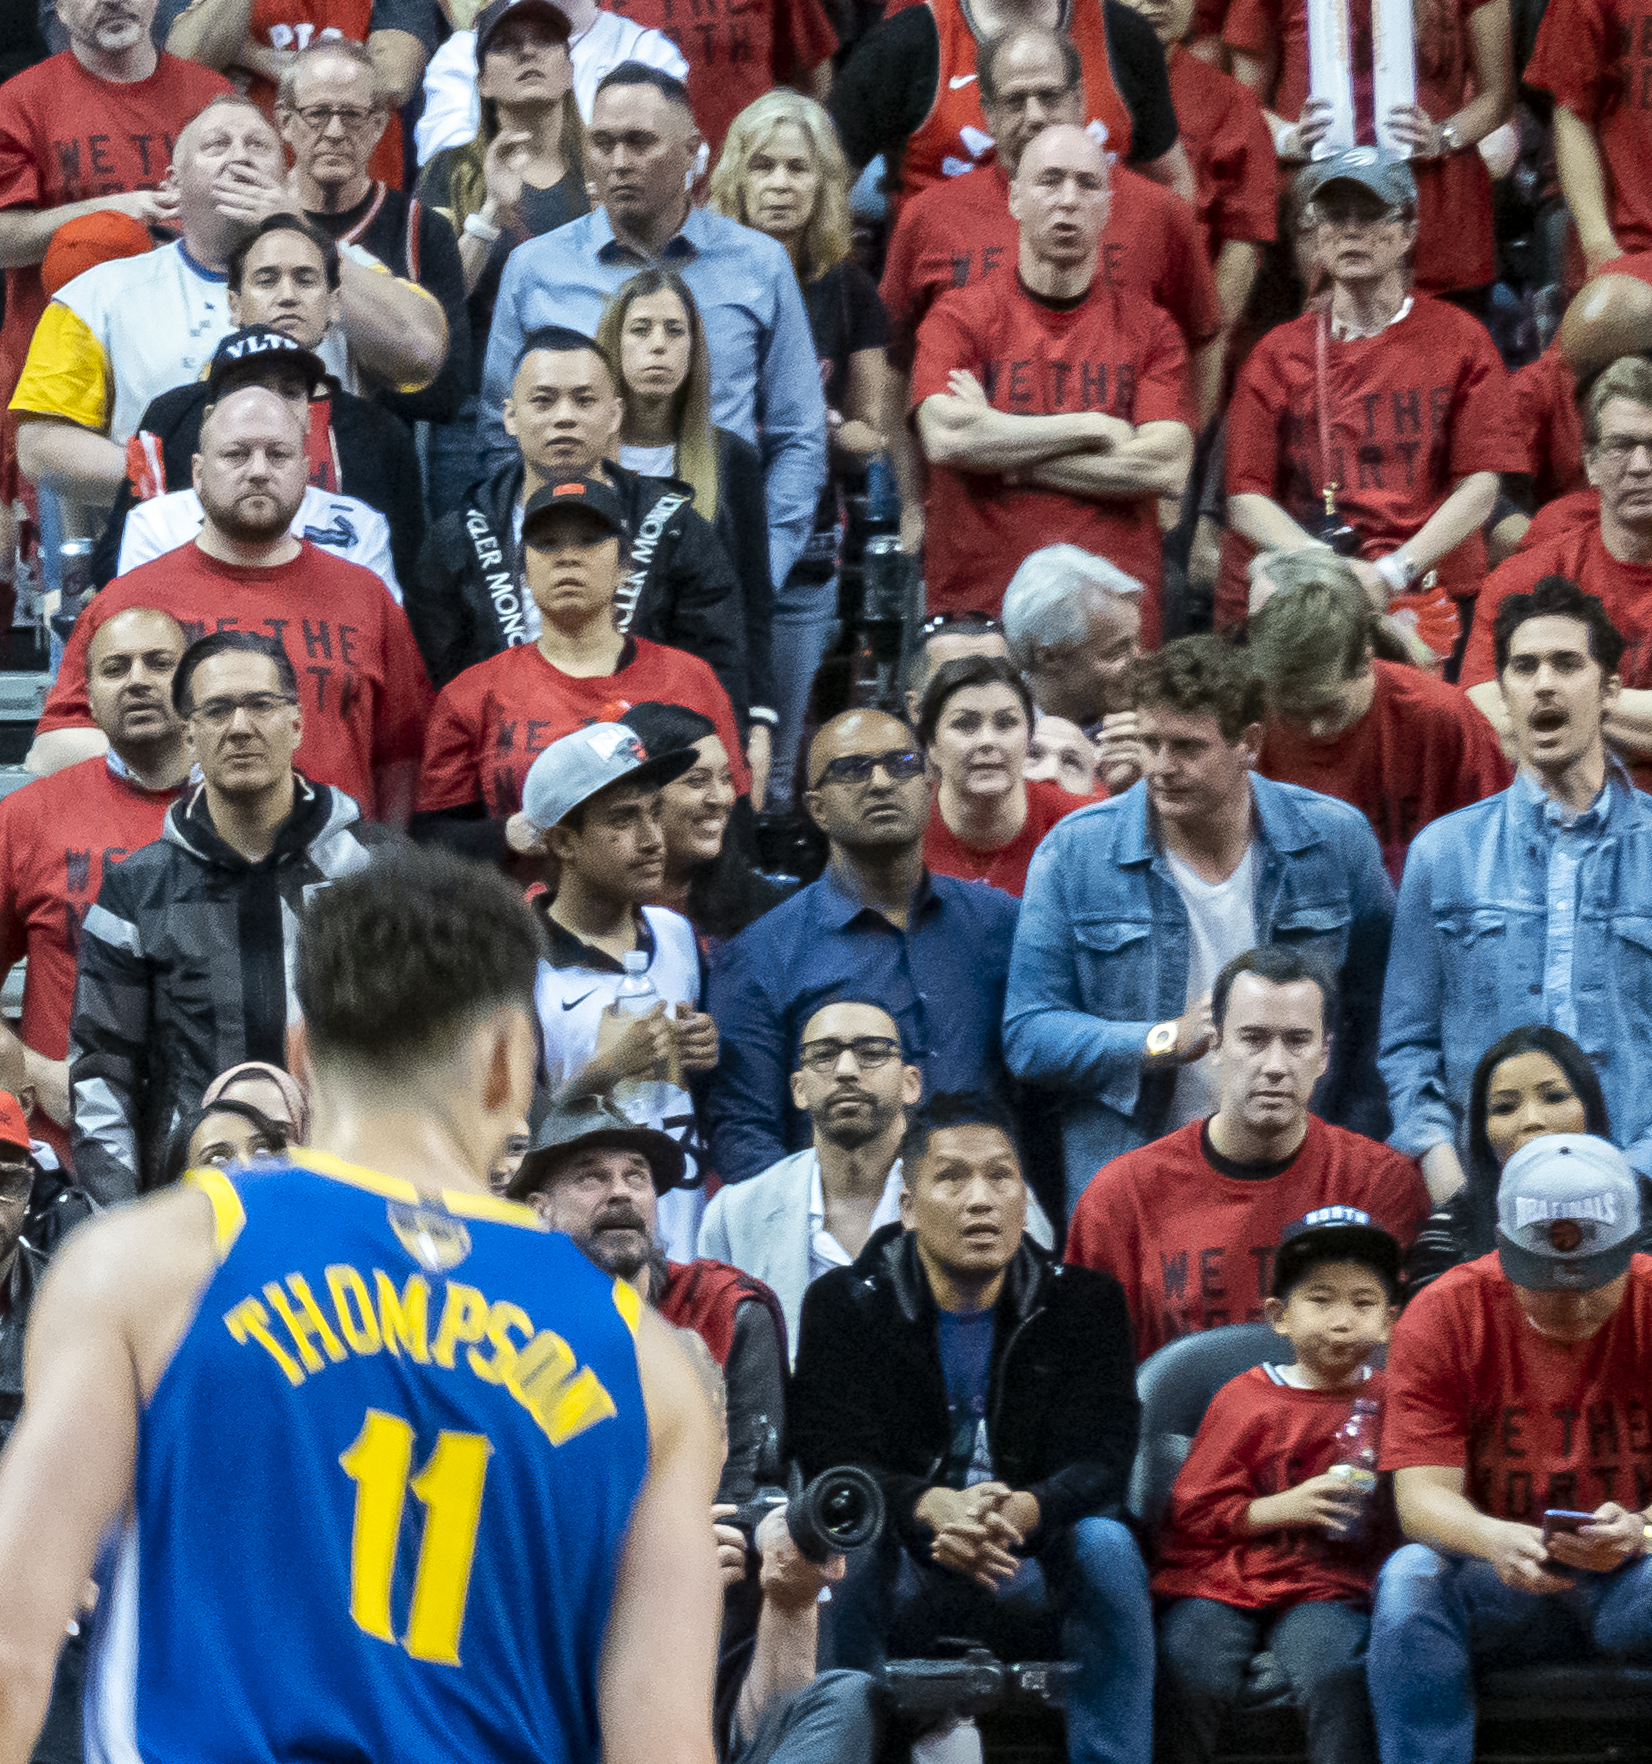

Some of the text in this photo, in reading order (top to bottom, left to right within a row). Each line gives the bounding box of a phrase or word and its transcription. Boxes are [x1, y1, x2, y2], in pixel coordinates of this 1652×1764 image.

[224, 1263, 618, 1448] THOMPSON
[1160, 1249, 1226, 1299] WE
[338, 1406, 495, 1667] 11
